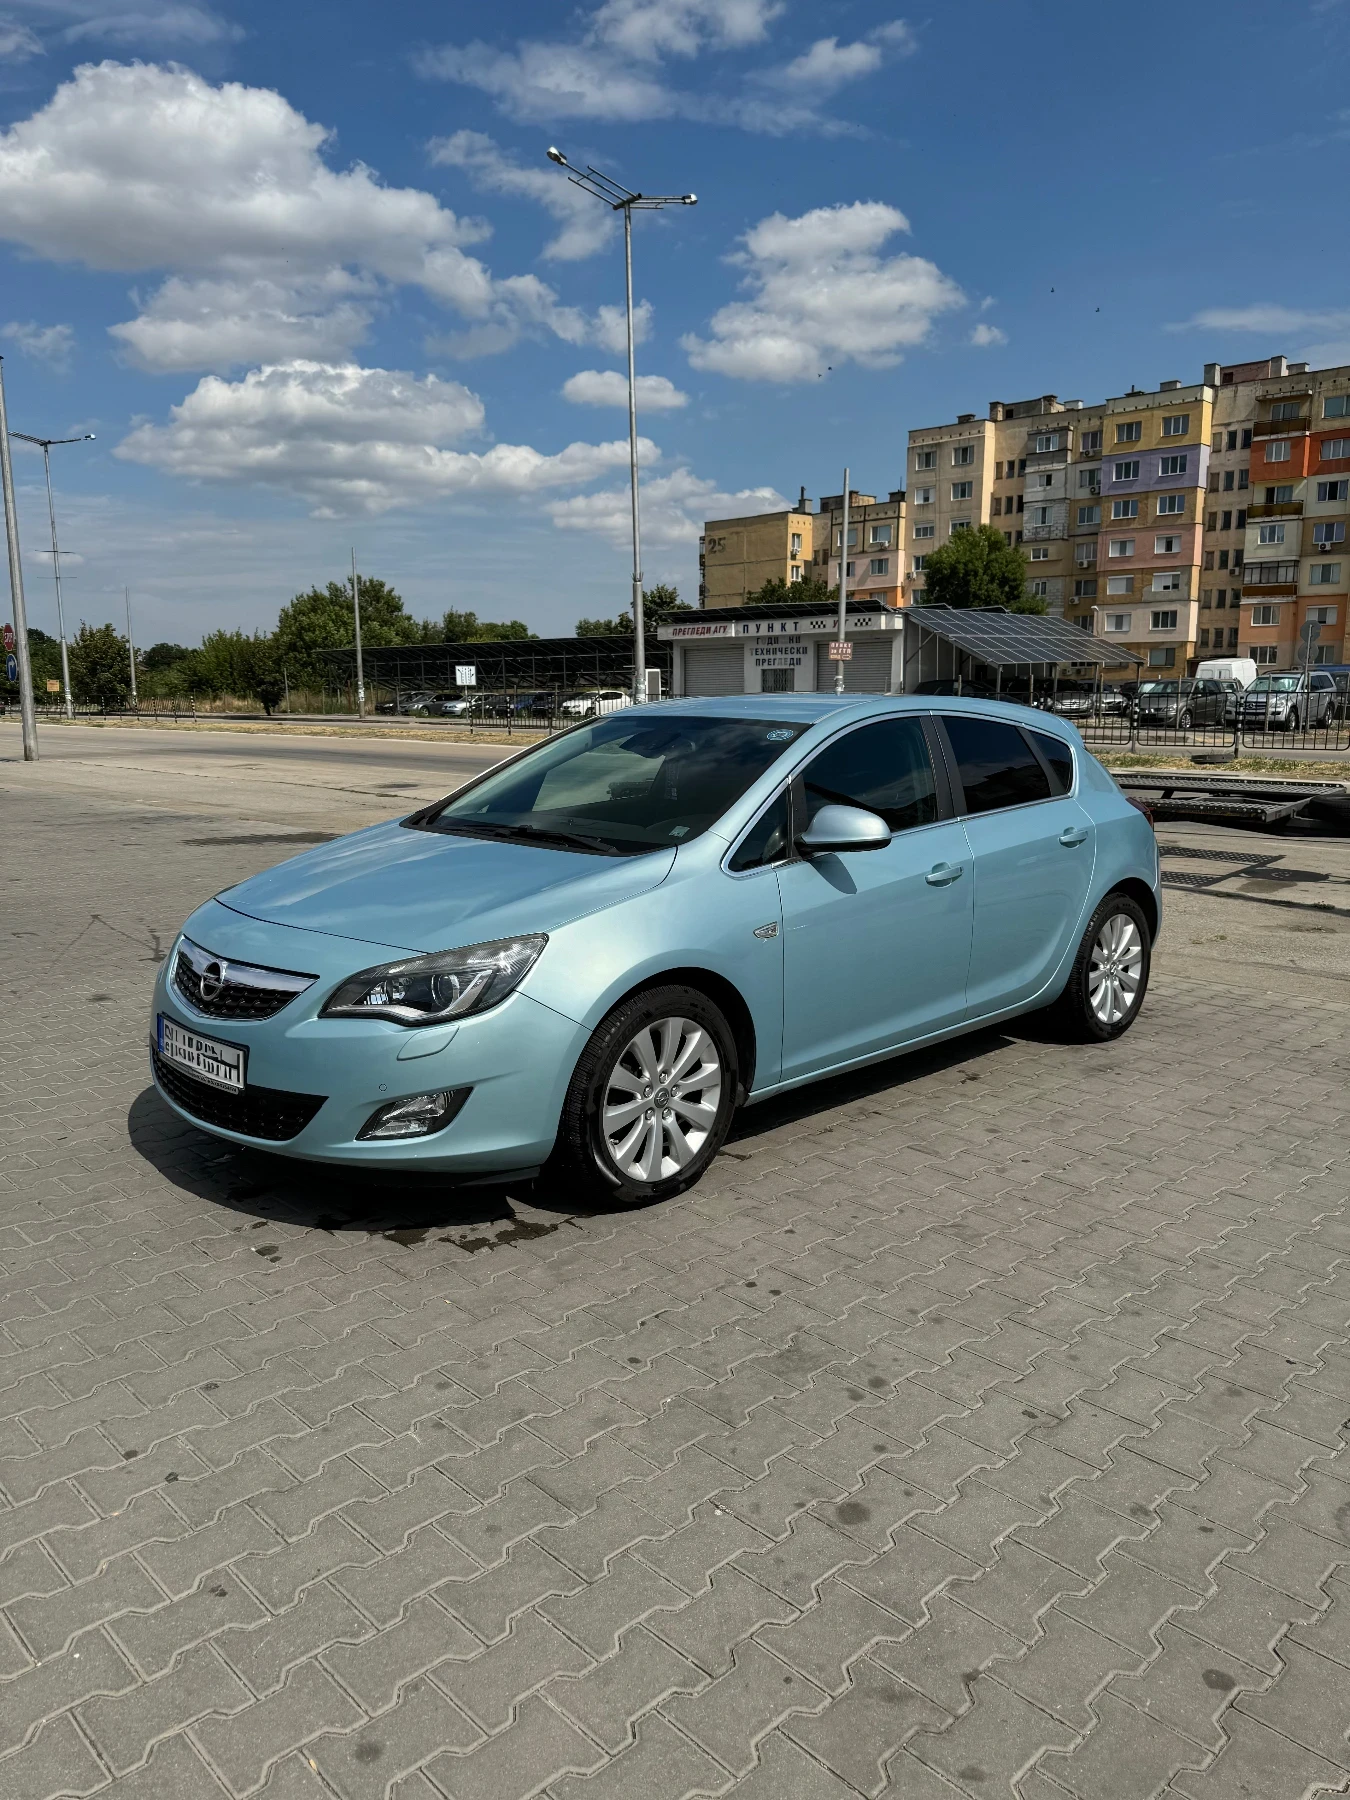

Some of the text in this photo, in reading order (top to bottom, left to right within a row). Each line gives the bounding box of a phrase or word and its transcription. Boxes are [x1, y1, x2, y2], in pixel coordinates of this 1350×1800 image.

[708, 537, 726, 555] 25
[743, 621, 799, 634] ПУНКТ
[749, 646, 808, 656] ТЕХНИЧЕСКИ
[756, 657, 801, 667] ПРЕГЛЕДИ
